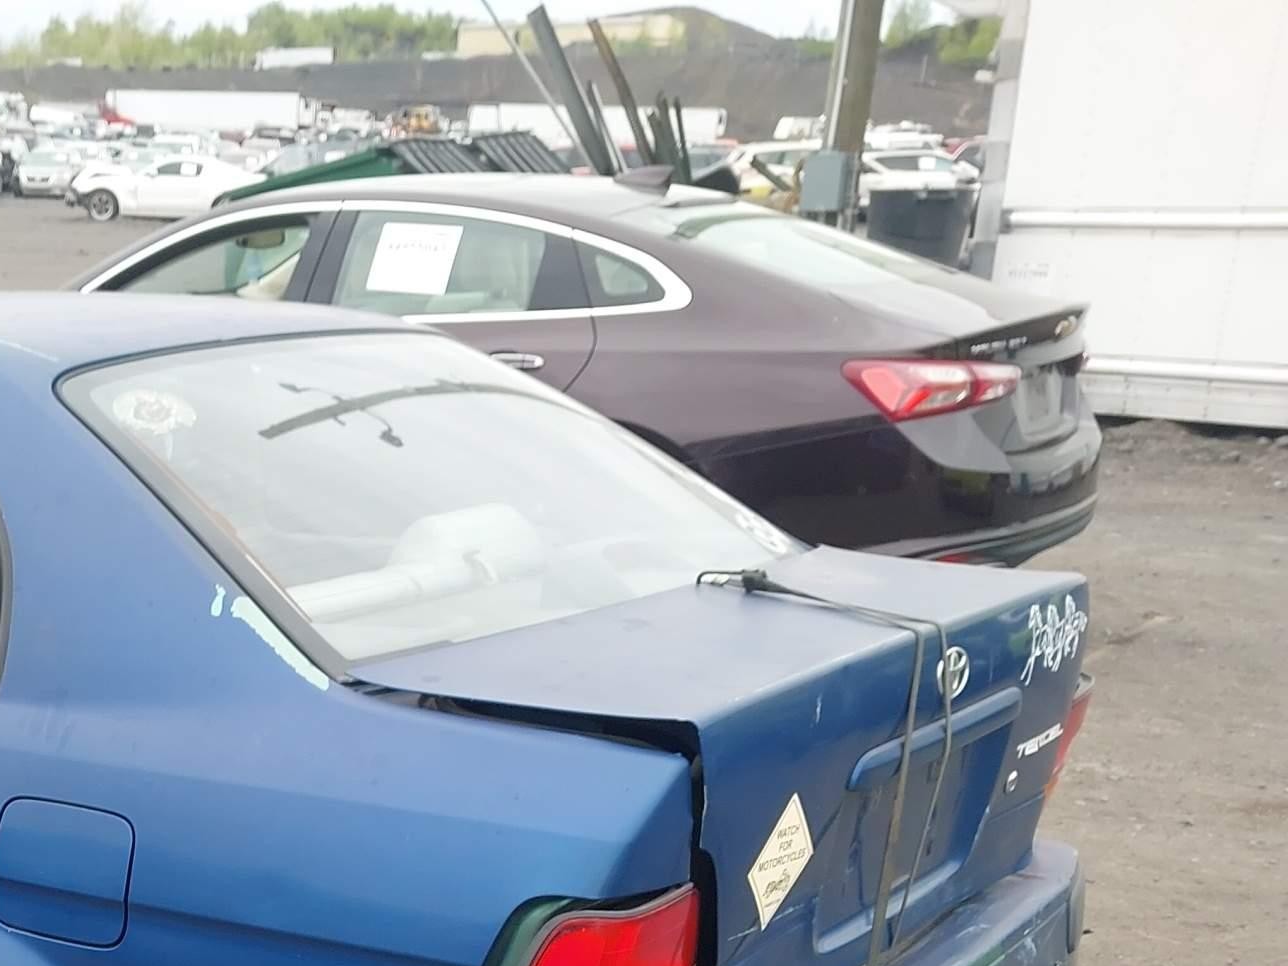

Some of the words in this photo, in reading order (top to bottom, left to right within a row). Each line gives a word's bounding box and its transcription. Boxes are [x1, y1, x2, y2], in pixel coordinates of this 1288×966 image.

[776, 824, 800, 840] WATCH
[778, 839, 793, 853] FOR
[758, 848, 806, 873] MOTORCYCLES
